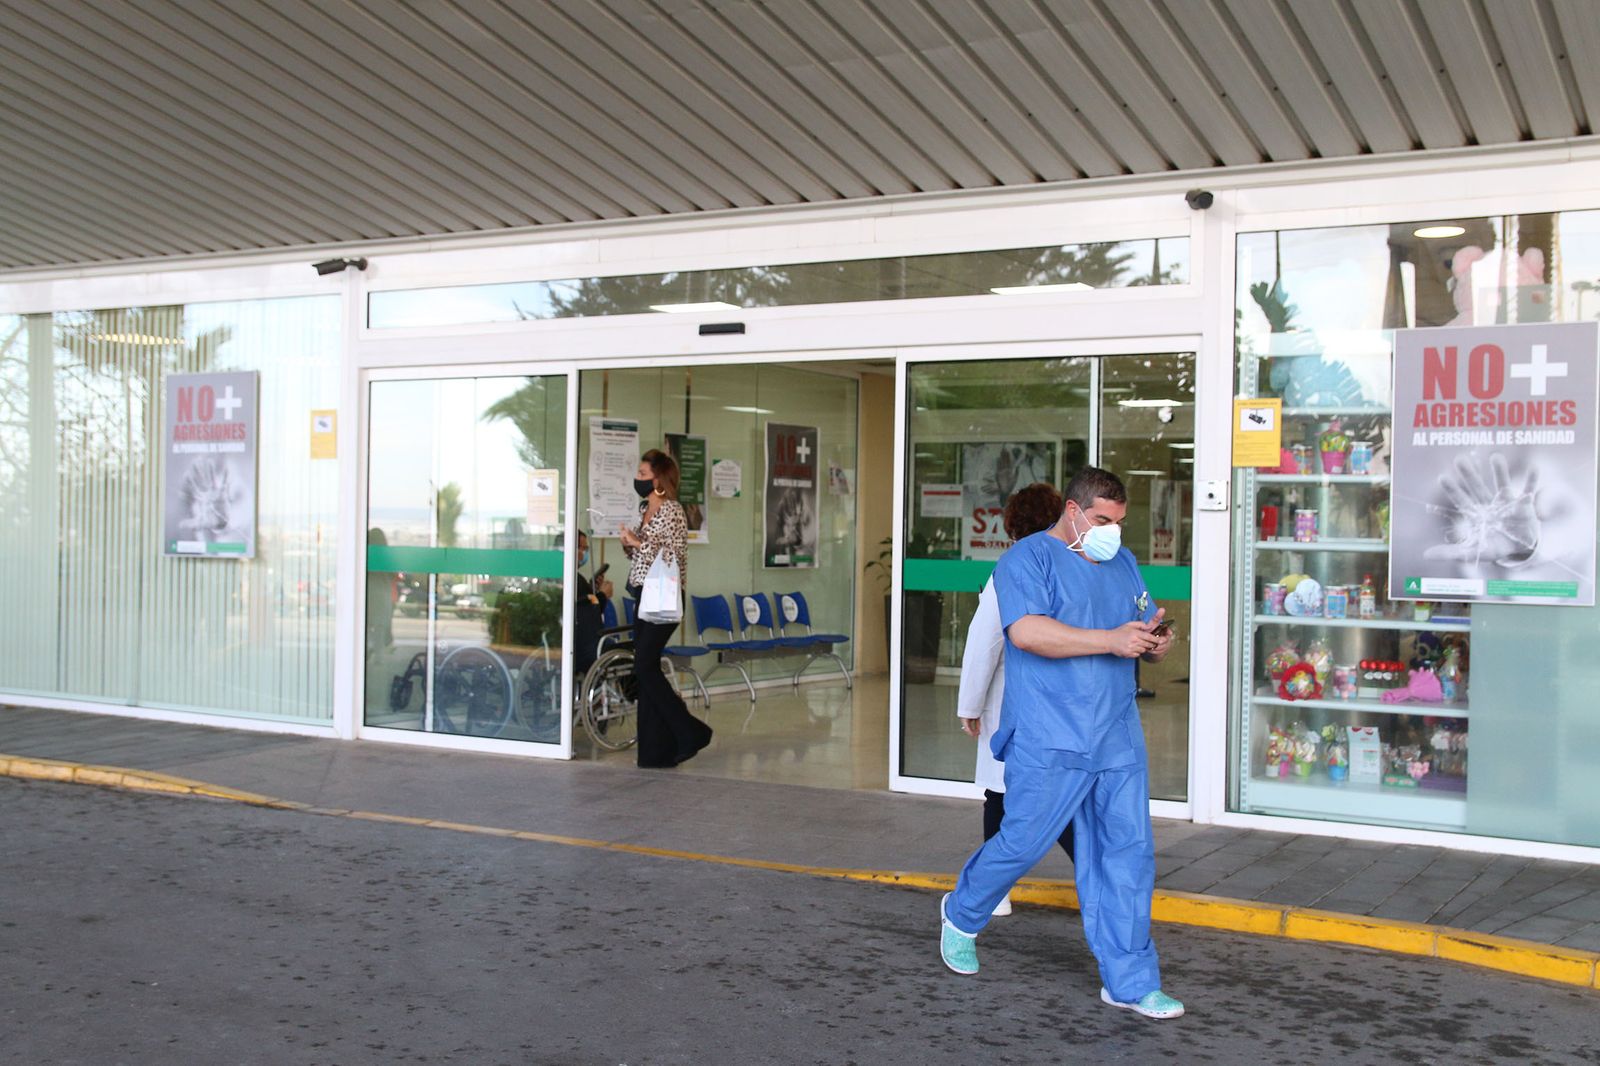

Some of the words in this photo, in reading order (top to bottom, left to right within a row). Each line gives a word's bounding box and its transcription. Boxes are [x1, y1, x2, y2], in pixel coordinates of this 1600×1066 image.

[1423, 344, 1504, 400] NO
[178, 386, 213, 422] NO
[1413, 401, 1577, 427] AGRESIONES
[174, 424, 245, 440] AGRESIONES
[1413, 432, 1428, 445] AL
[1430, 431, 1494, 445] PERSONAL
[1496, 430, 1513, 445] DE
[1514, 430, 1575, 445] SANIDAD
